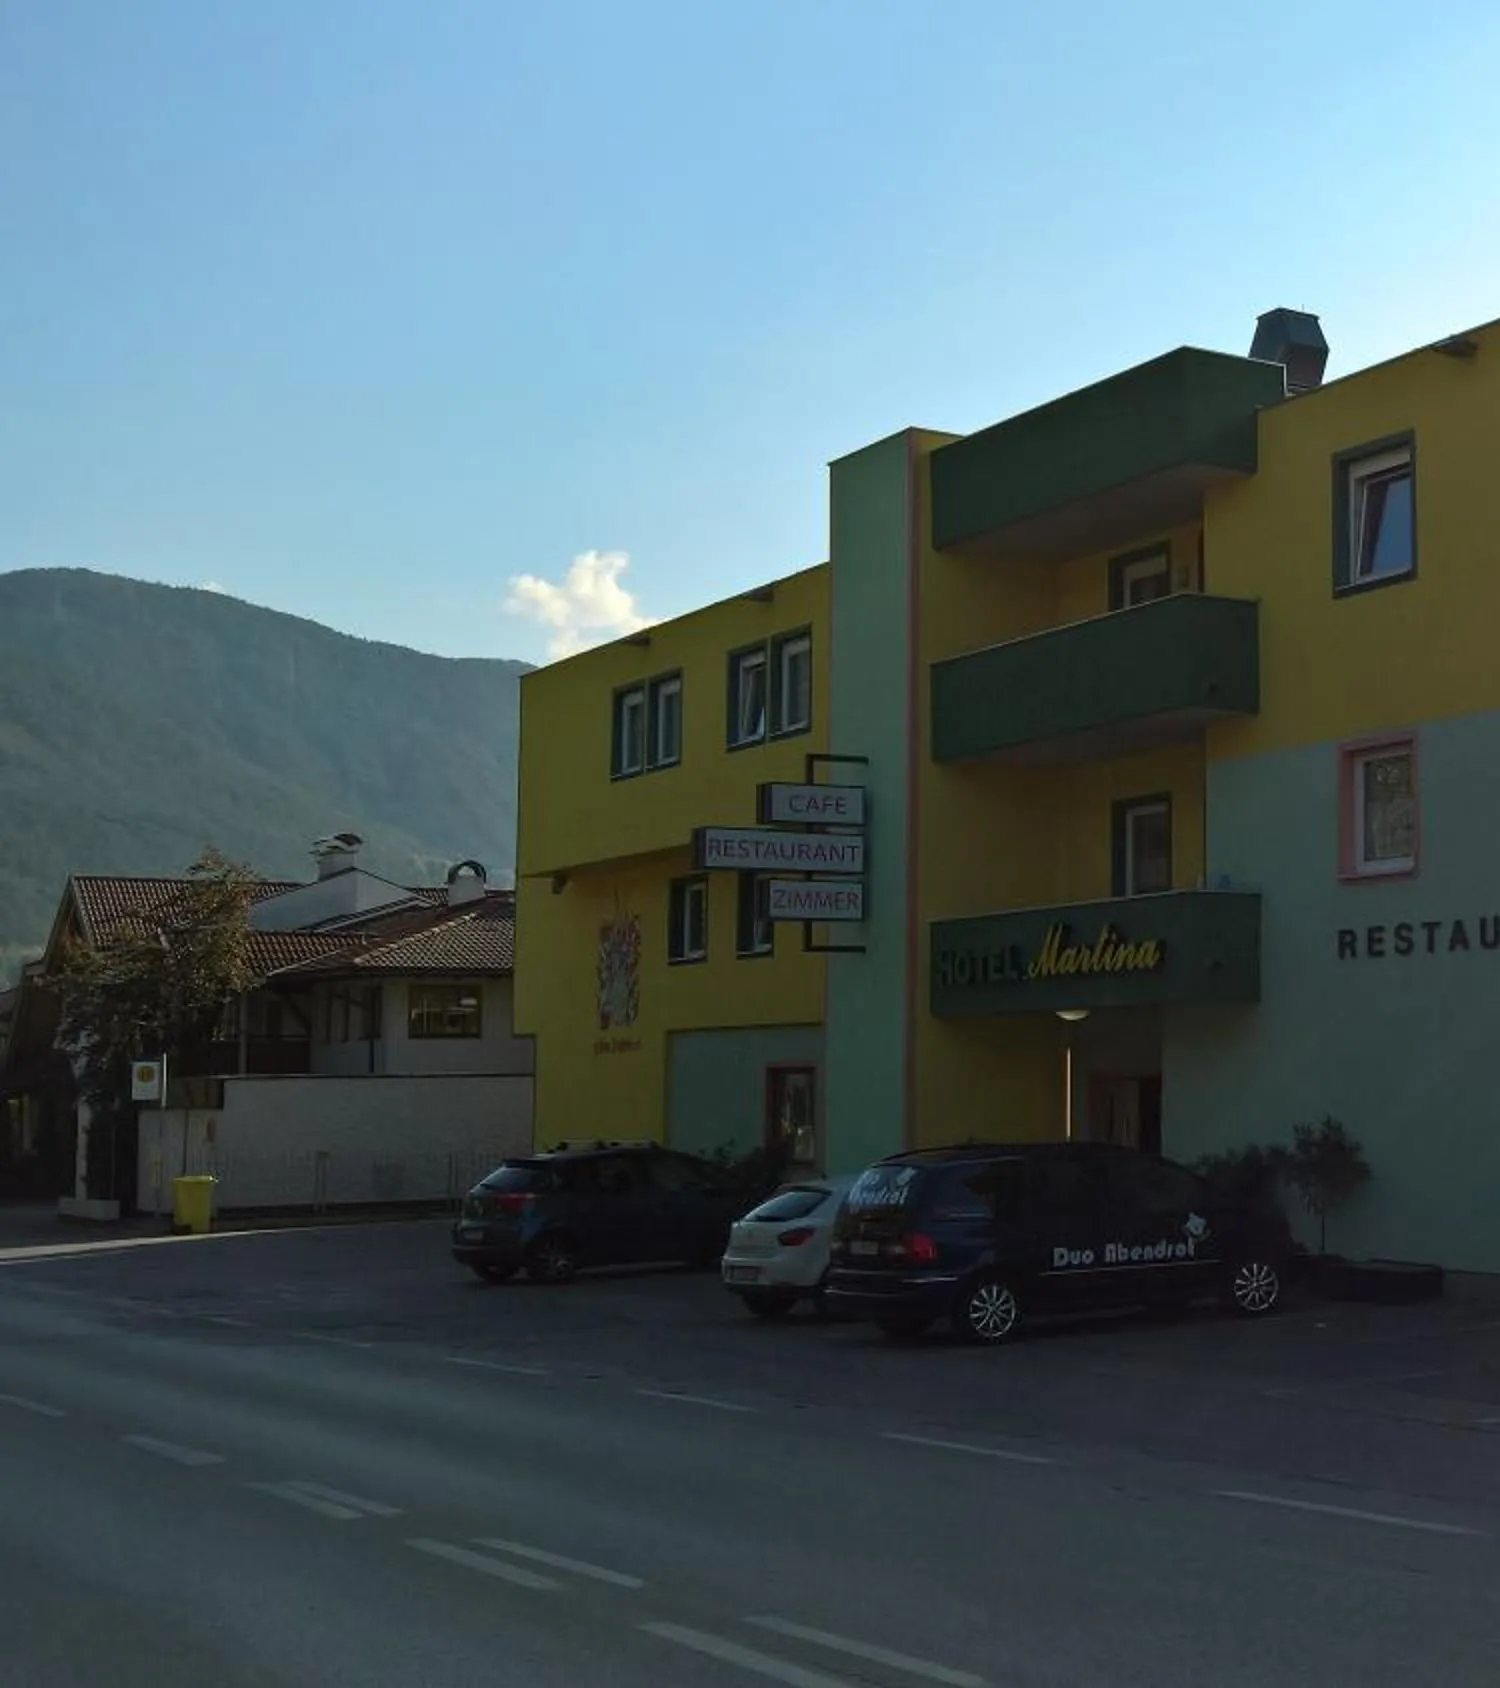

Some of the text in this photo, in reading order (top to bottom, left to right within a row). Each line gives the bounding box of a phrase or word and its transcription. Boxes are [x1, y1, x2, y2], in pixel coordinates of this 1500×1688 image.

[789, 795, 848, 815] CAFE
[708, 838, 861, 863] RESTAURANT
[773, 889, 860, 911] ZIMMER
[939, 922, 1162, 986] HOTEL Martina
[1052, 1236, 1196, 1268] Duo Abendrot
